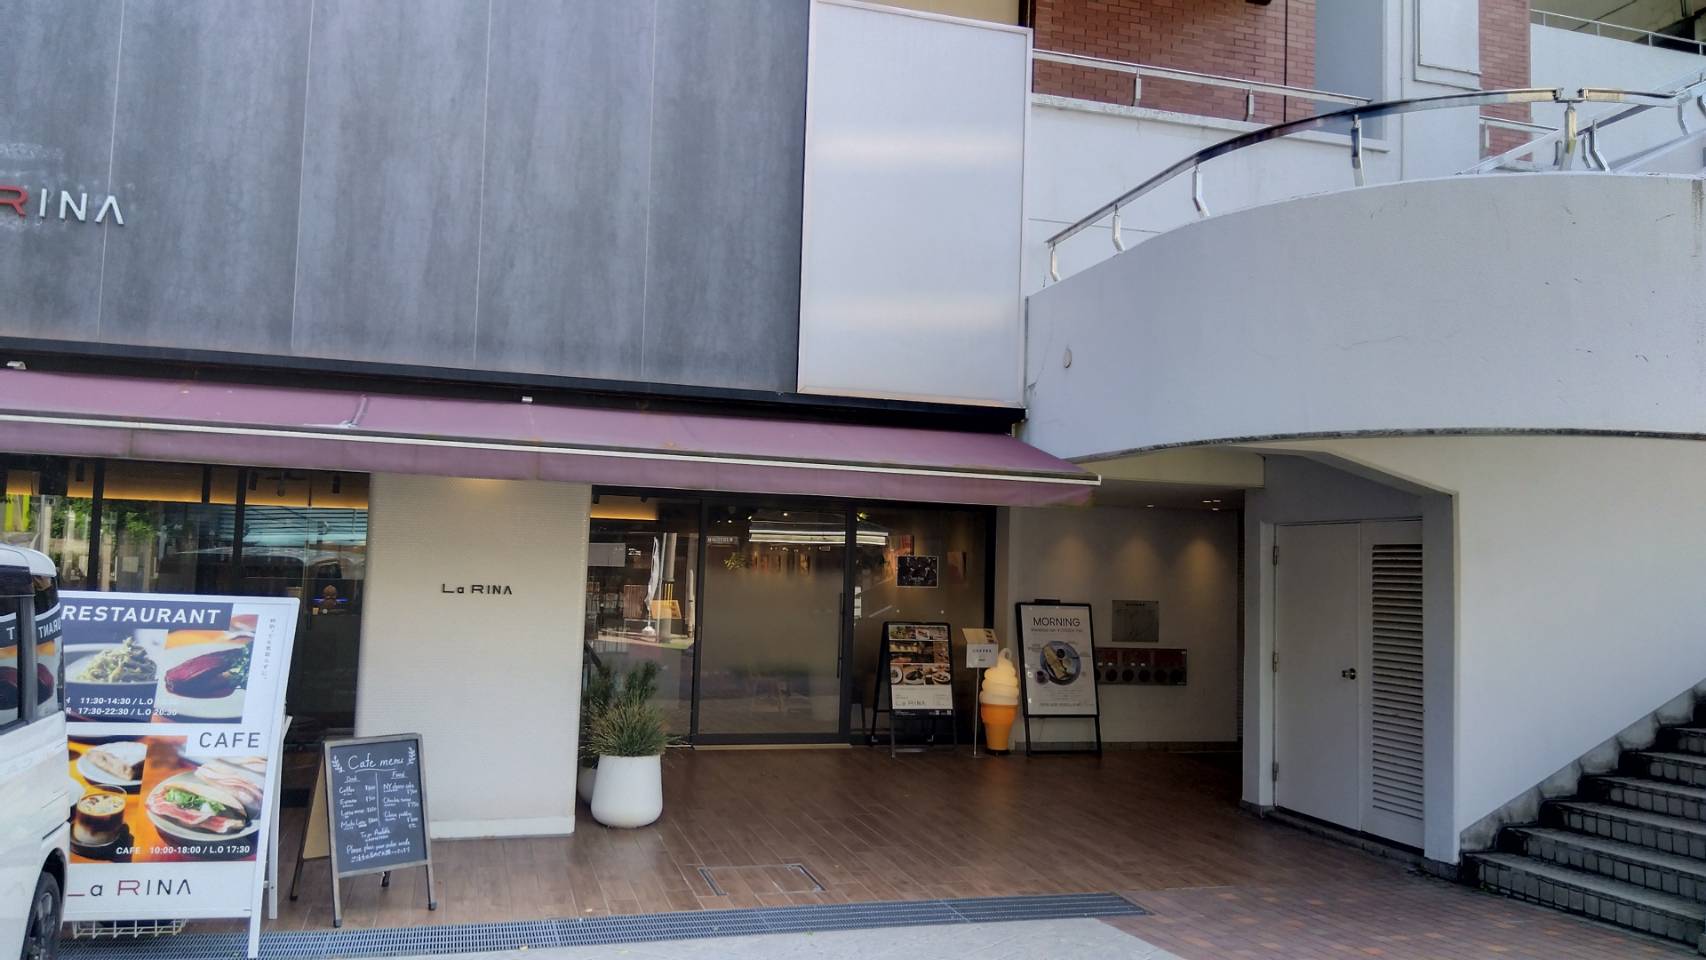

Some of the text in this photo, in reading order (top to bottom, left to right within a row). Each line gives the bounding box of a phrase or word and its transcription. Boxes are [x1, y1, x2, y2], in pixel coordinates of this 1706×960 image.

[442, 584, 512, 595] La RINA
[61, 605, 221, 624] RESTAURANT
[1033, 617, 1080, 627] MORNING
[80, 697, 131, 705] 11:30-14:30
[78, 707, 129, 715] 17:30-22:30
[199, 732, 261, 749] CAFE
[348, 753, 404, 769] Cafe menu
[226, 845, 250, 854] 17:30
[117, 879, 192, 896] RINA
